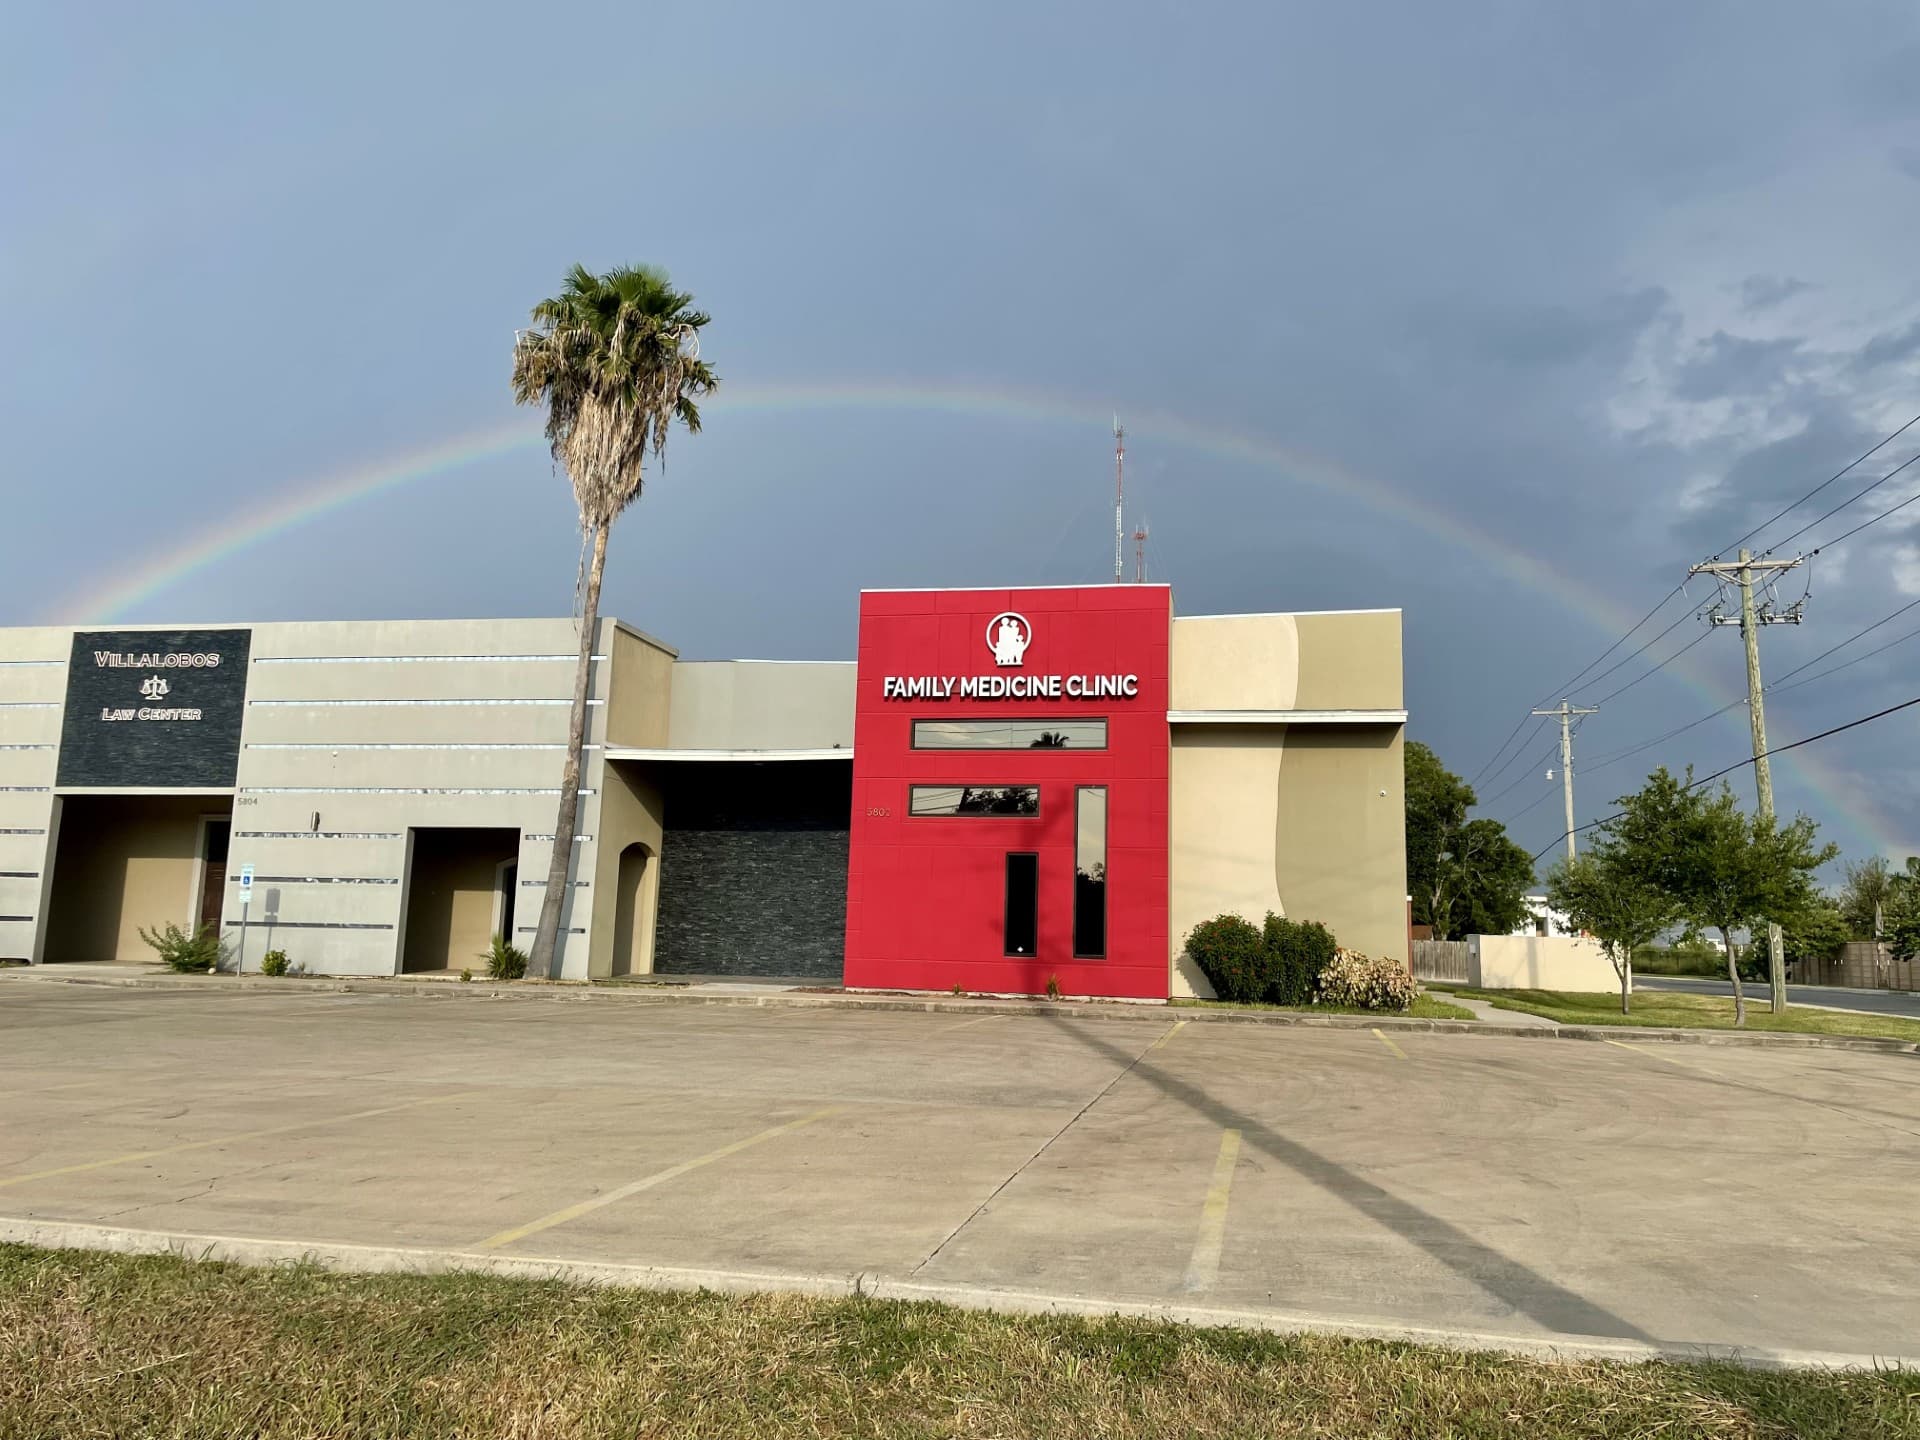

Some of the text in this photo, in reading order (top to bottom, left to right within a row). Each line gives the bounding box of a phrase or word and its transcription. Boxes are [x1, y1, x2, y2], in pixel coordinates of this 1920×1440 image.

[94, 651, 220, 668] VILLALOBOS
[883, 674, 1138, 697] FAMILY MEDICINE CLINIC
[102, 707, 202, 721] LAW CENTER
[237, 797, 258, 806] 5804
